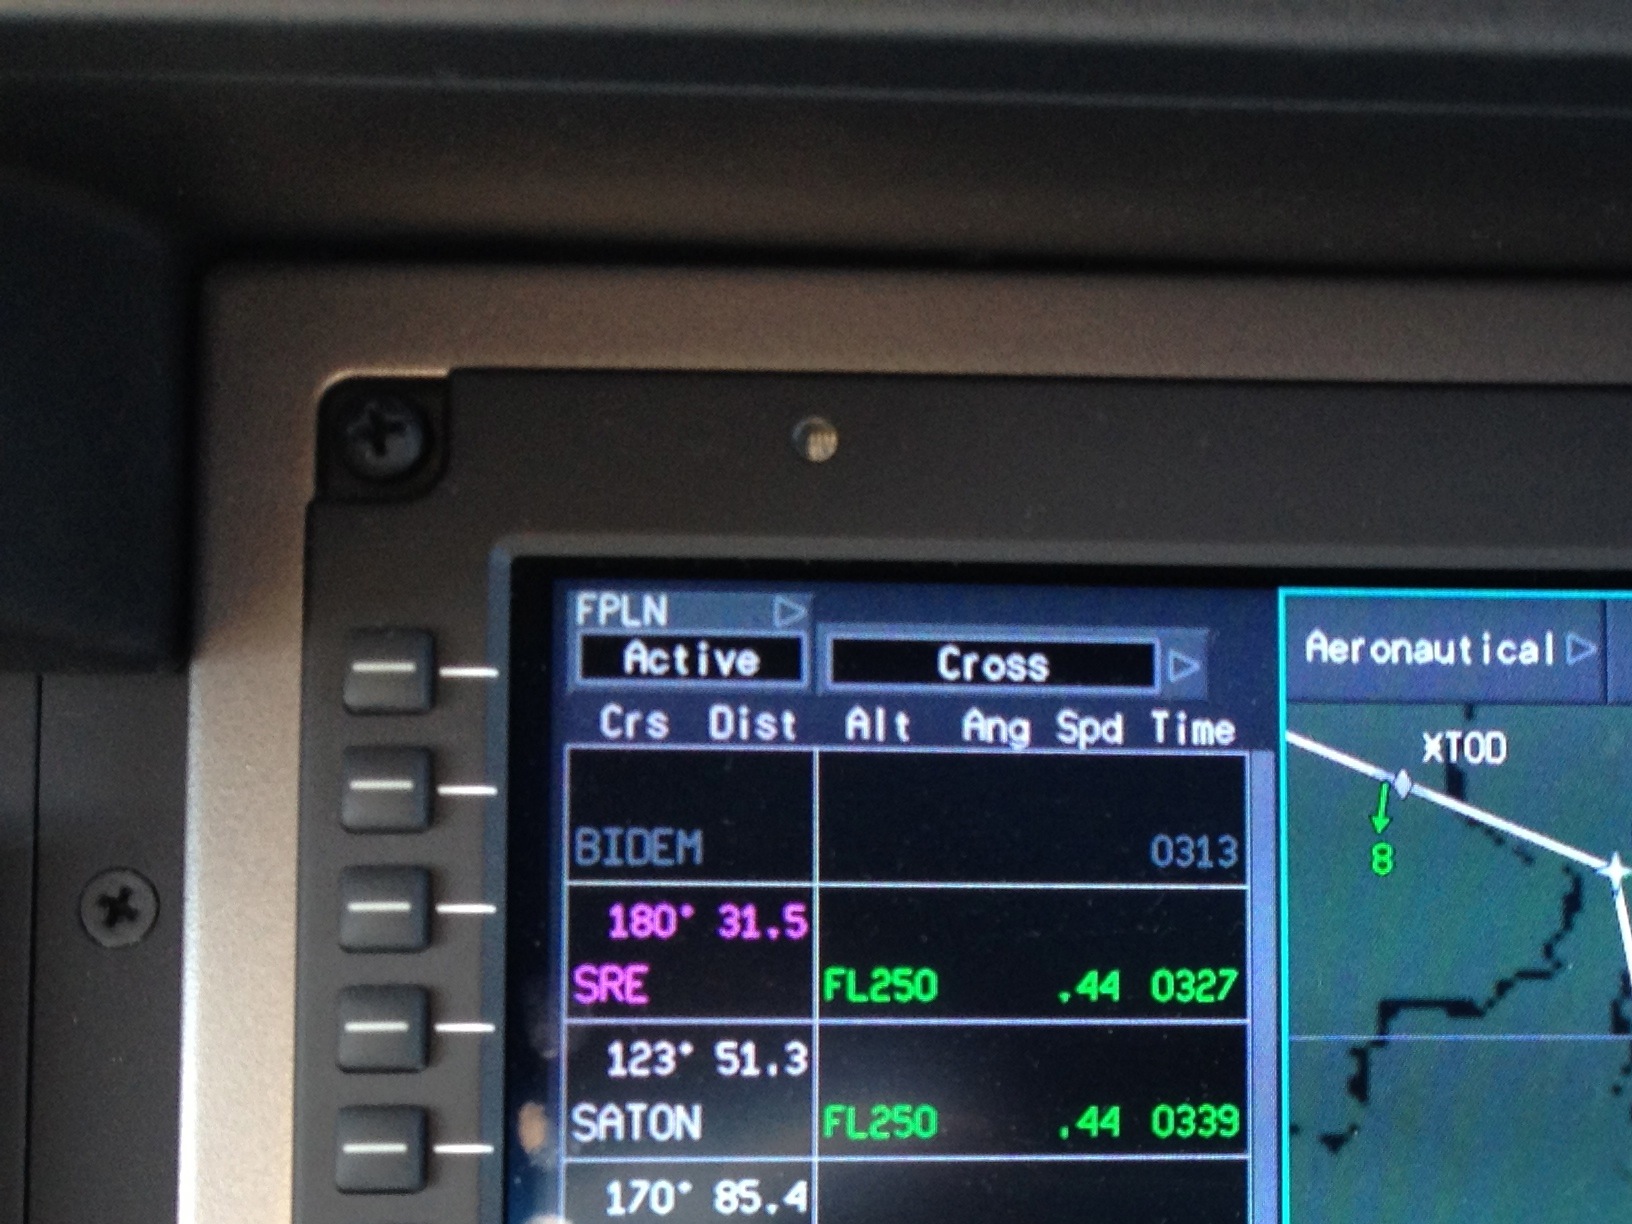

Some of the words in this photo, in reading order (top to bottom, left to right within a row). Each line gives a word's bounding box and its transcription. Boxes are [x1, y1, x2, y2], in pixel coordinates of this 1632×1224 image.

[576, 593, 667, 627] FPLN
[624, 646, 761, 676] Active
[938, 646, 1050, 682] Cross
[1306, 631, 1554, 666] Aeronautical
[600, 706, 669, 739] Crs
[708, 706, 796, 741] Dist
[846, 709, 910, 741] Alt
[963, 711, 1030, 749] Ang
[1056, 712, 1123, 747] Spd
[1153, 712, 1235, 746] Time
[1422, 731, 1507, 764] XTOD
[576, 829, 704, 866] BIDEM
[1152, 837, 1240, 868] 0313
[1371, 843, 1394, 875] 8
[718, 903, 808, 940] 31.5
[574, 965, 650, 1004] SRE
[823, 968, 938, 1002] FL250
[1059, 971, 1120, 1002] .44
[1152, 970, 1240, 1004] 0327
[715, 1042, 808, 1076] 51.3
[572, 1103, 701, 1142] SATON
[823, 1105, 938, 1140] FL250
[1059, 1106, 1120, 1139] .44
[1152, 1105, 1241, 1139] 0339
[713, 1180, 808, 1215] 85.4
